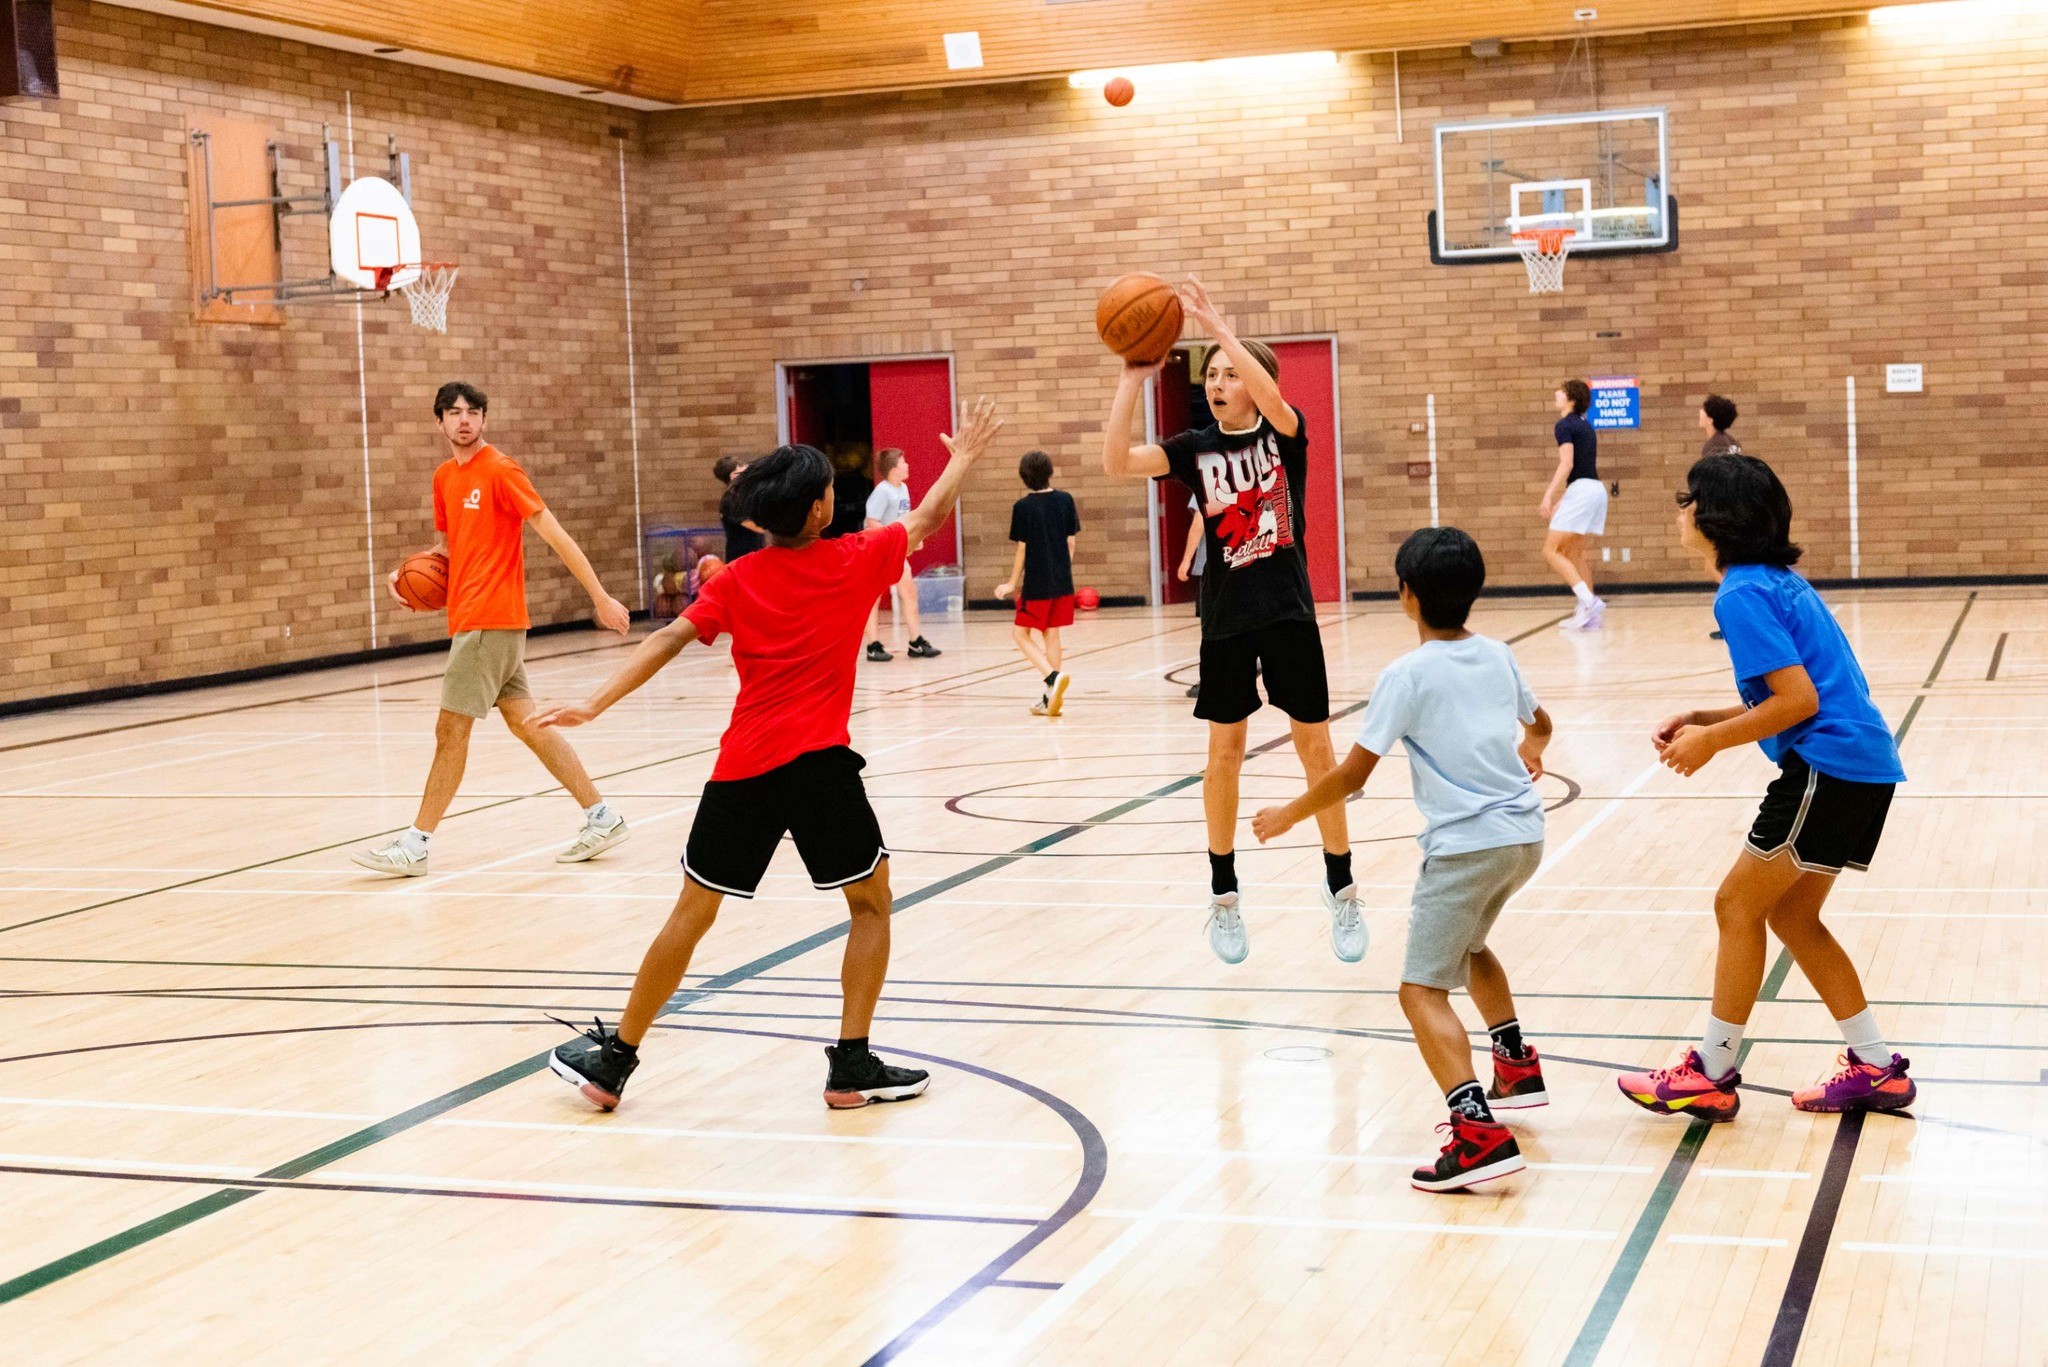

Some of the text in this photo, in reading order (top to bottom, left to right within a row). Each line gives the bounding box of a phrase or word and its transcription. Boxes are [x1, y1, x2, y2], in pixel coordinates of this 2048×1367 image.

[1592, 379, 1633, 389] WARNING
[1598, 389, 1627, 398] PLEASE
[1595, 398, 1631, 408] DO NOT
[1600, 408, 1627, 417] HANG
[1594, 417, 1634, 427] FROM RIM
